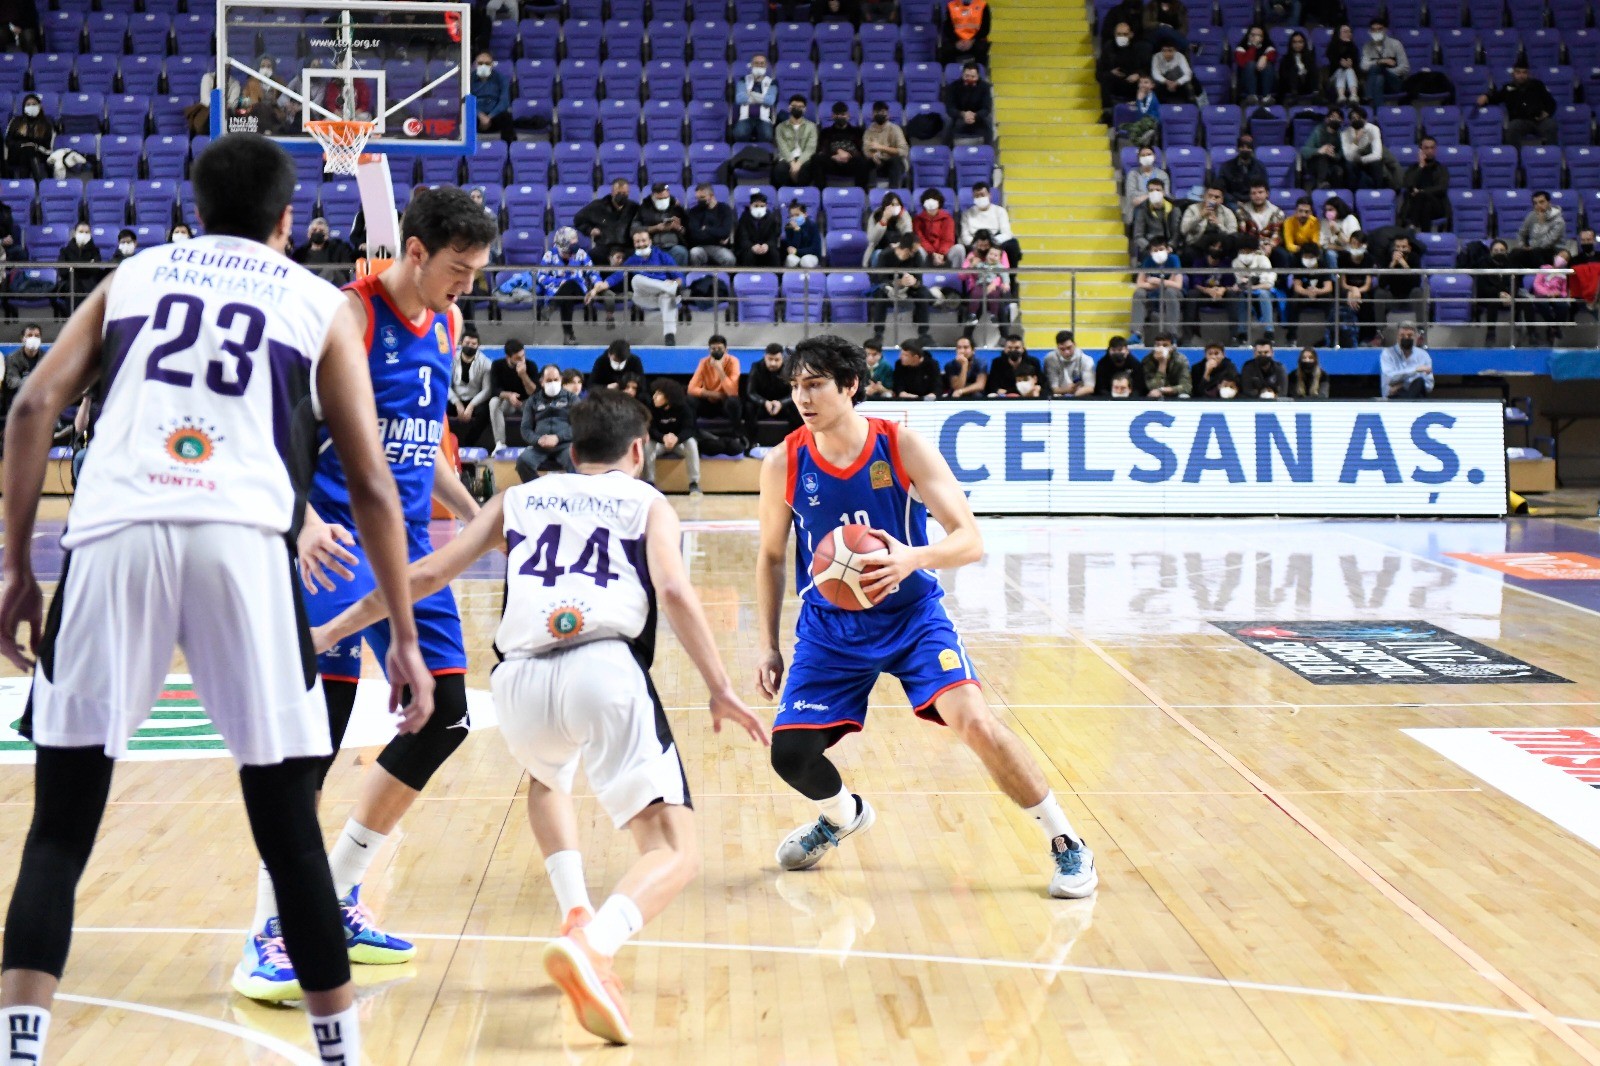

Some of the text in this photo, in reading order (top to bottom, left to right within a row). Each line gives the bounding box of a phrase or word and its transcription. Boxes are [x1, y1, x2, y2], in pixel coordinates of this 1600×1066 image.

[152, 265, 291, 303] PARKHAYAT
[145, 293, 267, 397] 23
[418, 366, 432, 407] 3
[938, 410, 1487, 505] ÇELSAN AŞ.
[525, 495, 625, 513] PARKHAYAT
[518, 523, 620, 589] 44
